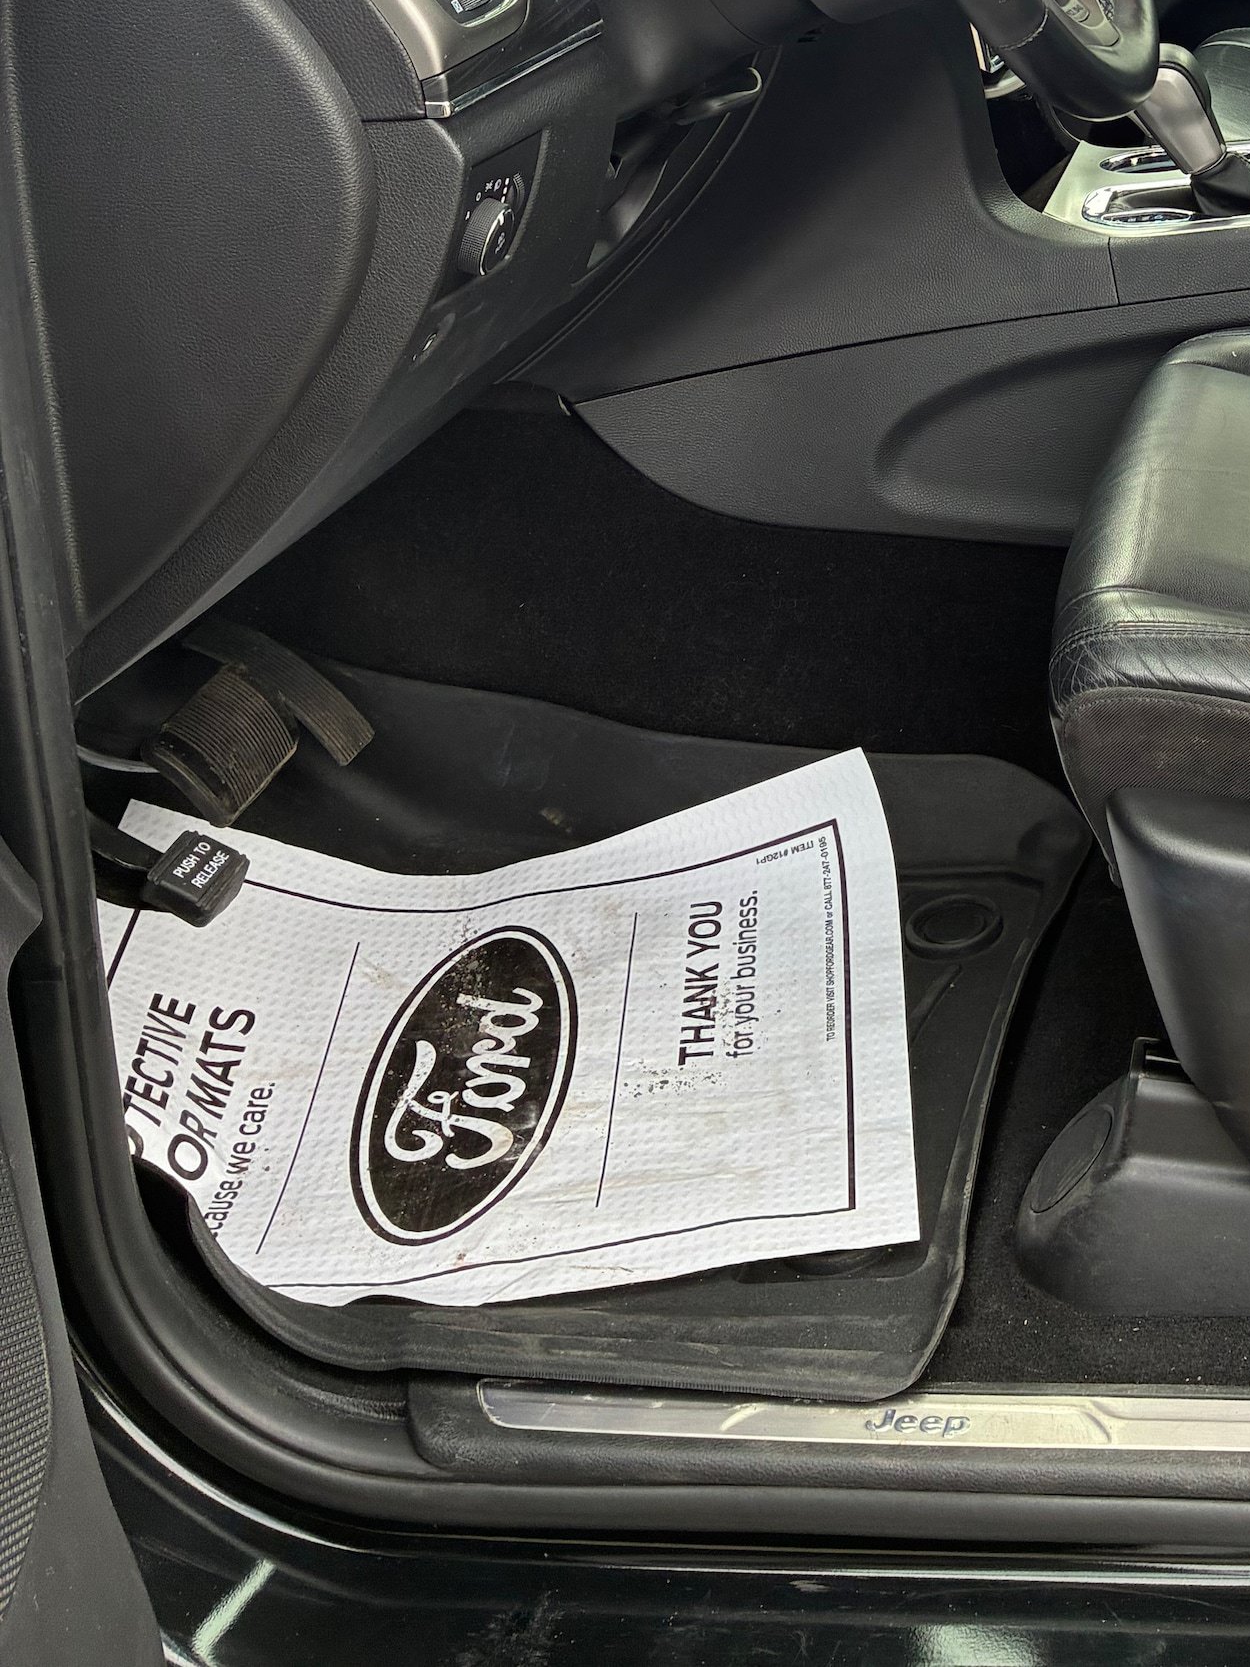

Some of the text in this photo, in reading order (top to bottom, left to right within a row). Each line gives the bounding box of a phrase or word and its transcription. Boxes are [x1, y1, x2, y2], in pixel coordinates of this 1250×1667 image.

[172, 841, 211, 879] PUSH TO
[791, 839, 814, 855] ITEM
[191, 850, 230, 889] RELEASE
[823, 890, 834, 911] CALL
[824, 919, 835, 986] SHOPFORDGEAR.COM
[678, 900, 724, 1066] THANK YOU
[725, 890, 760, 1059] for your business.
[825, 986, 835, 1002] VISIT
[826, 1003, 835, 1033] REORDER
[826, 1033, 835, 1042] TO
[185, 1006, 256, 1120] MATS
[383, 986, 544, 1170] Ford
[238, 1082, 276, 1136] care.
[226, 1139, 256, 1179] we
[865, 1409, 971, 1438] Jeep
